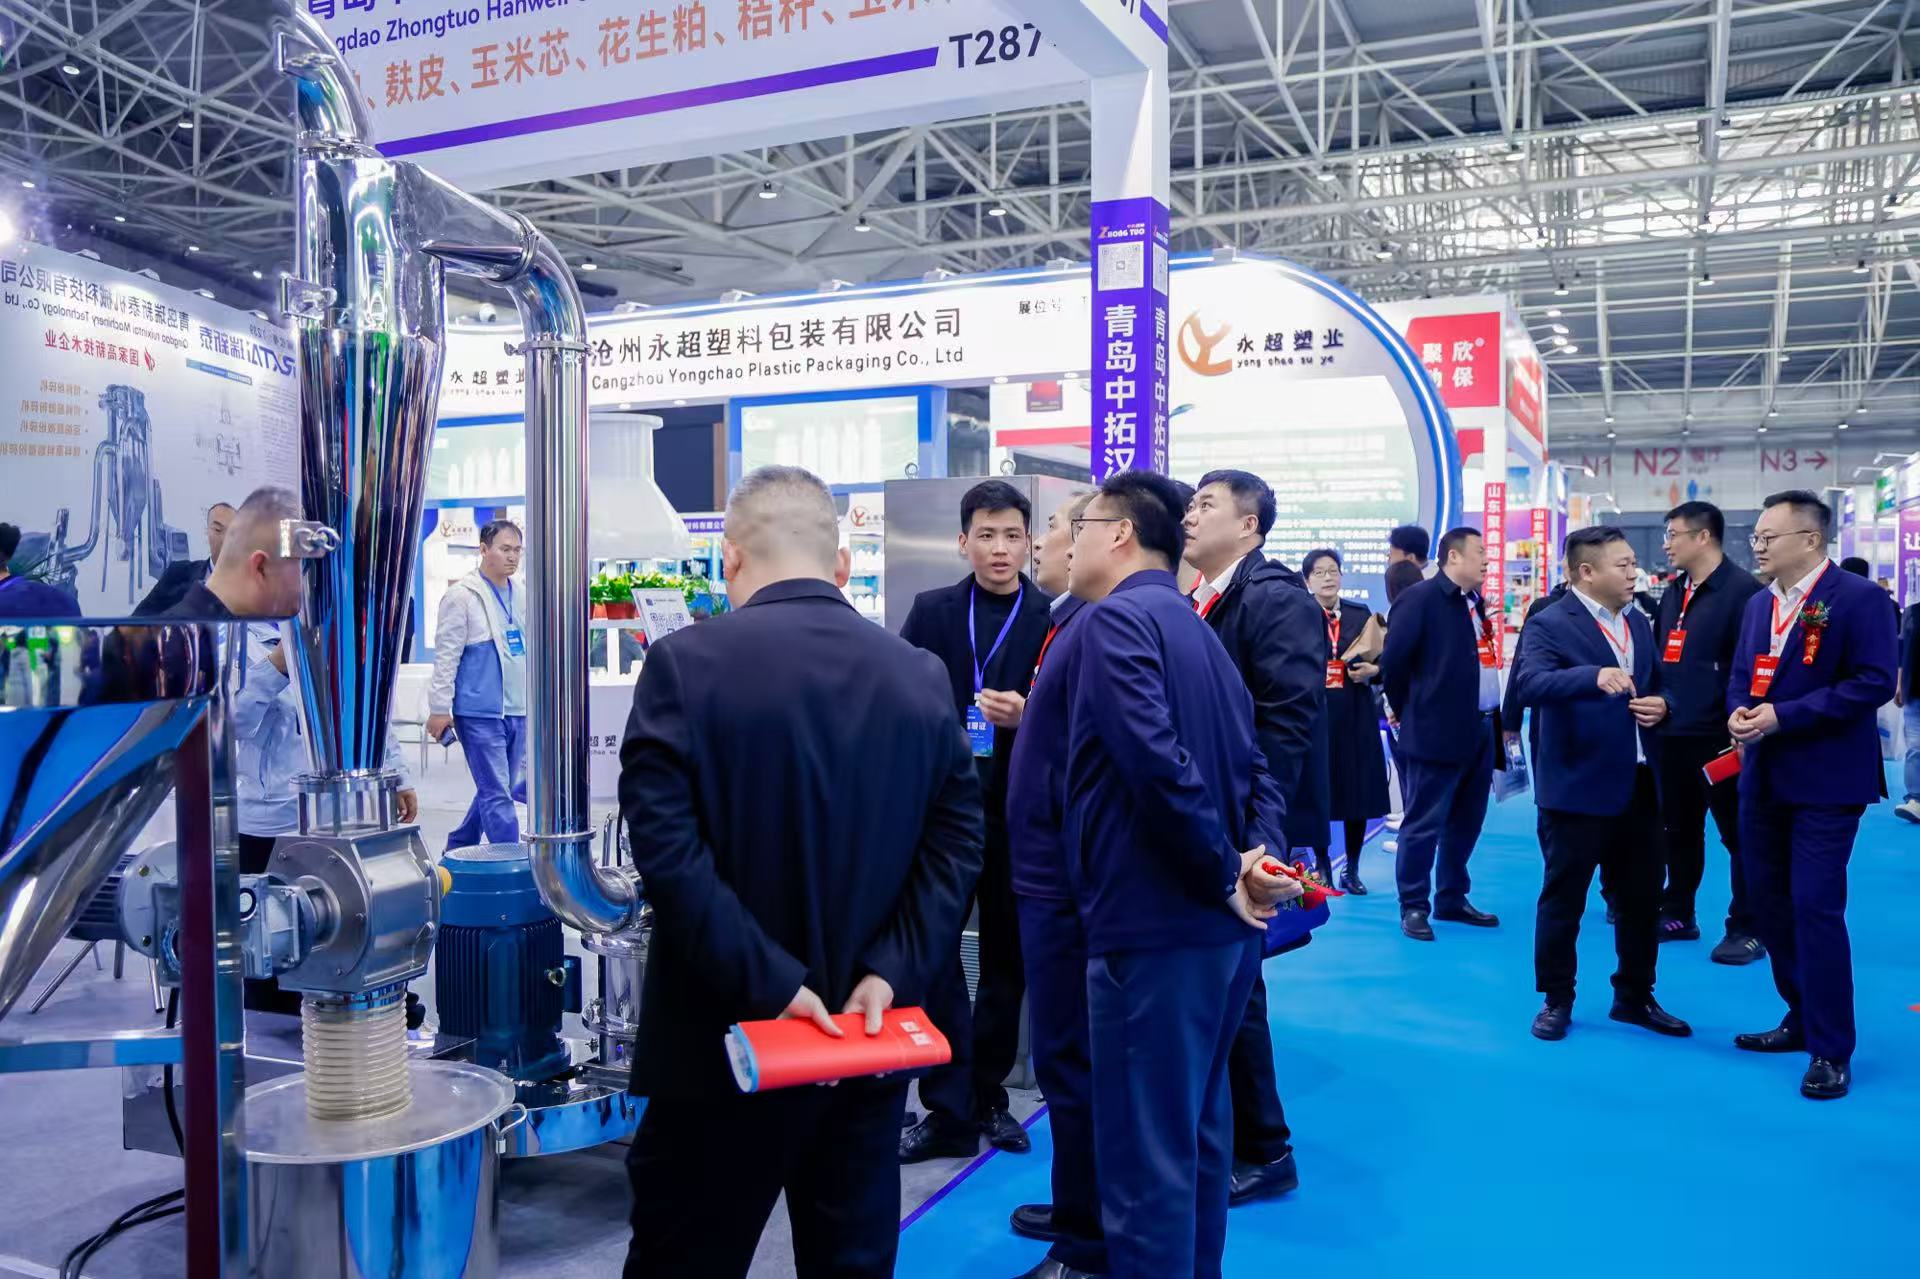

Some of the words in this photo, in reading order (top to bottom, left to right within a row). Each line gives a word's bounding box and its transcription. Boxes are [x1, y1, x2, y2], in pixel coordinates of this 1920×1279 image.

[336, 27, 380, 55] gdao
[386, 8, 480, 42] Zhongtuo
[487, 0, 568, 20] Hanwe
[587, 307, 961, 367] 沧州永超塑料包装有限公司
[1237, 328, 1344, 353] 永超塑业
[592, 371, 664, 391] Cangzhou
[669, 364, 743, 385] Yongchao
[749, 359, 801, 377] Plastic
[806, 352, 892, 371] Packaging
[897, 350, 929, 367] Co.,
[935, 347, 964, 364] Ltd
[1633, 447, 1681, 477] N2
[1761, 448, 1798, 472] N3
